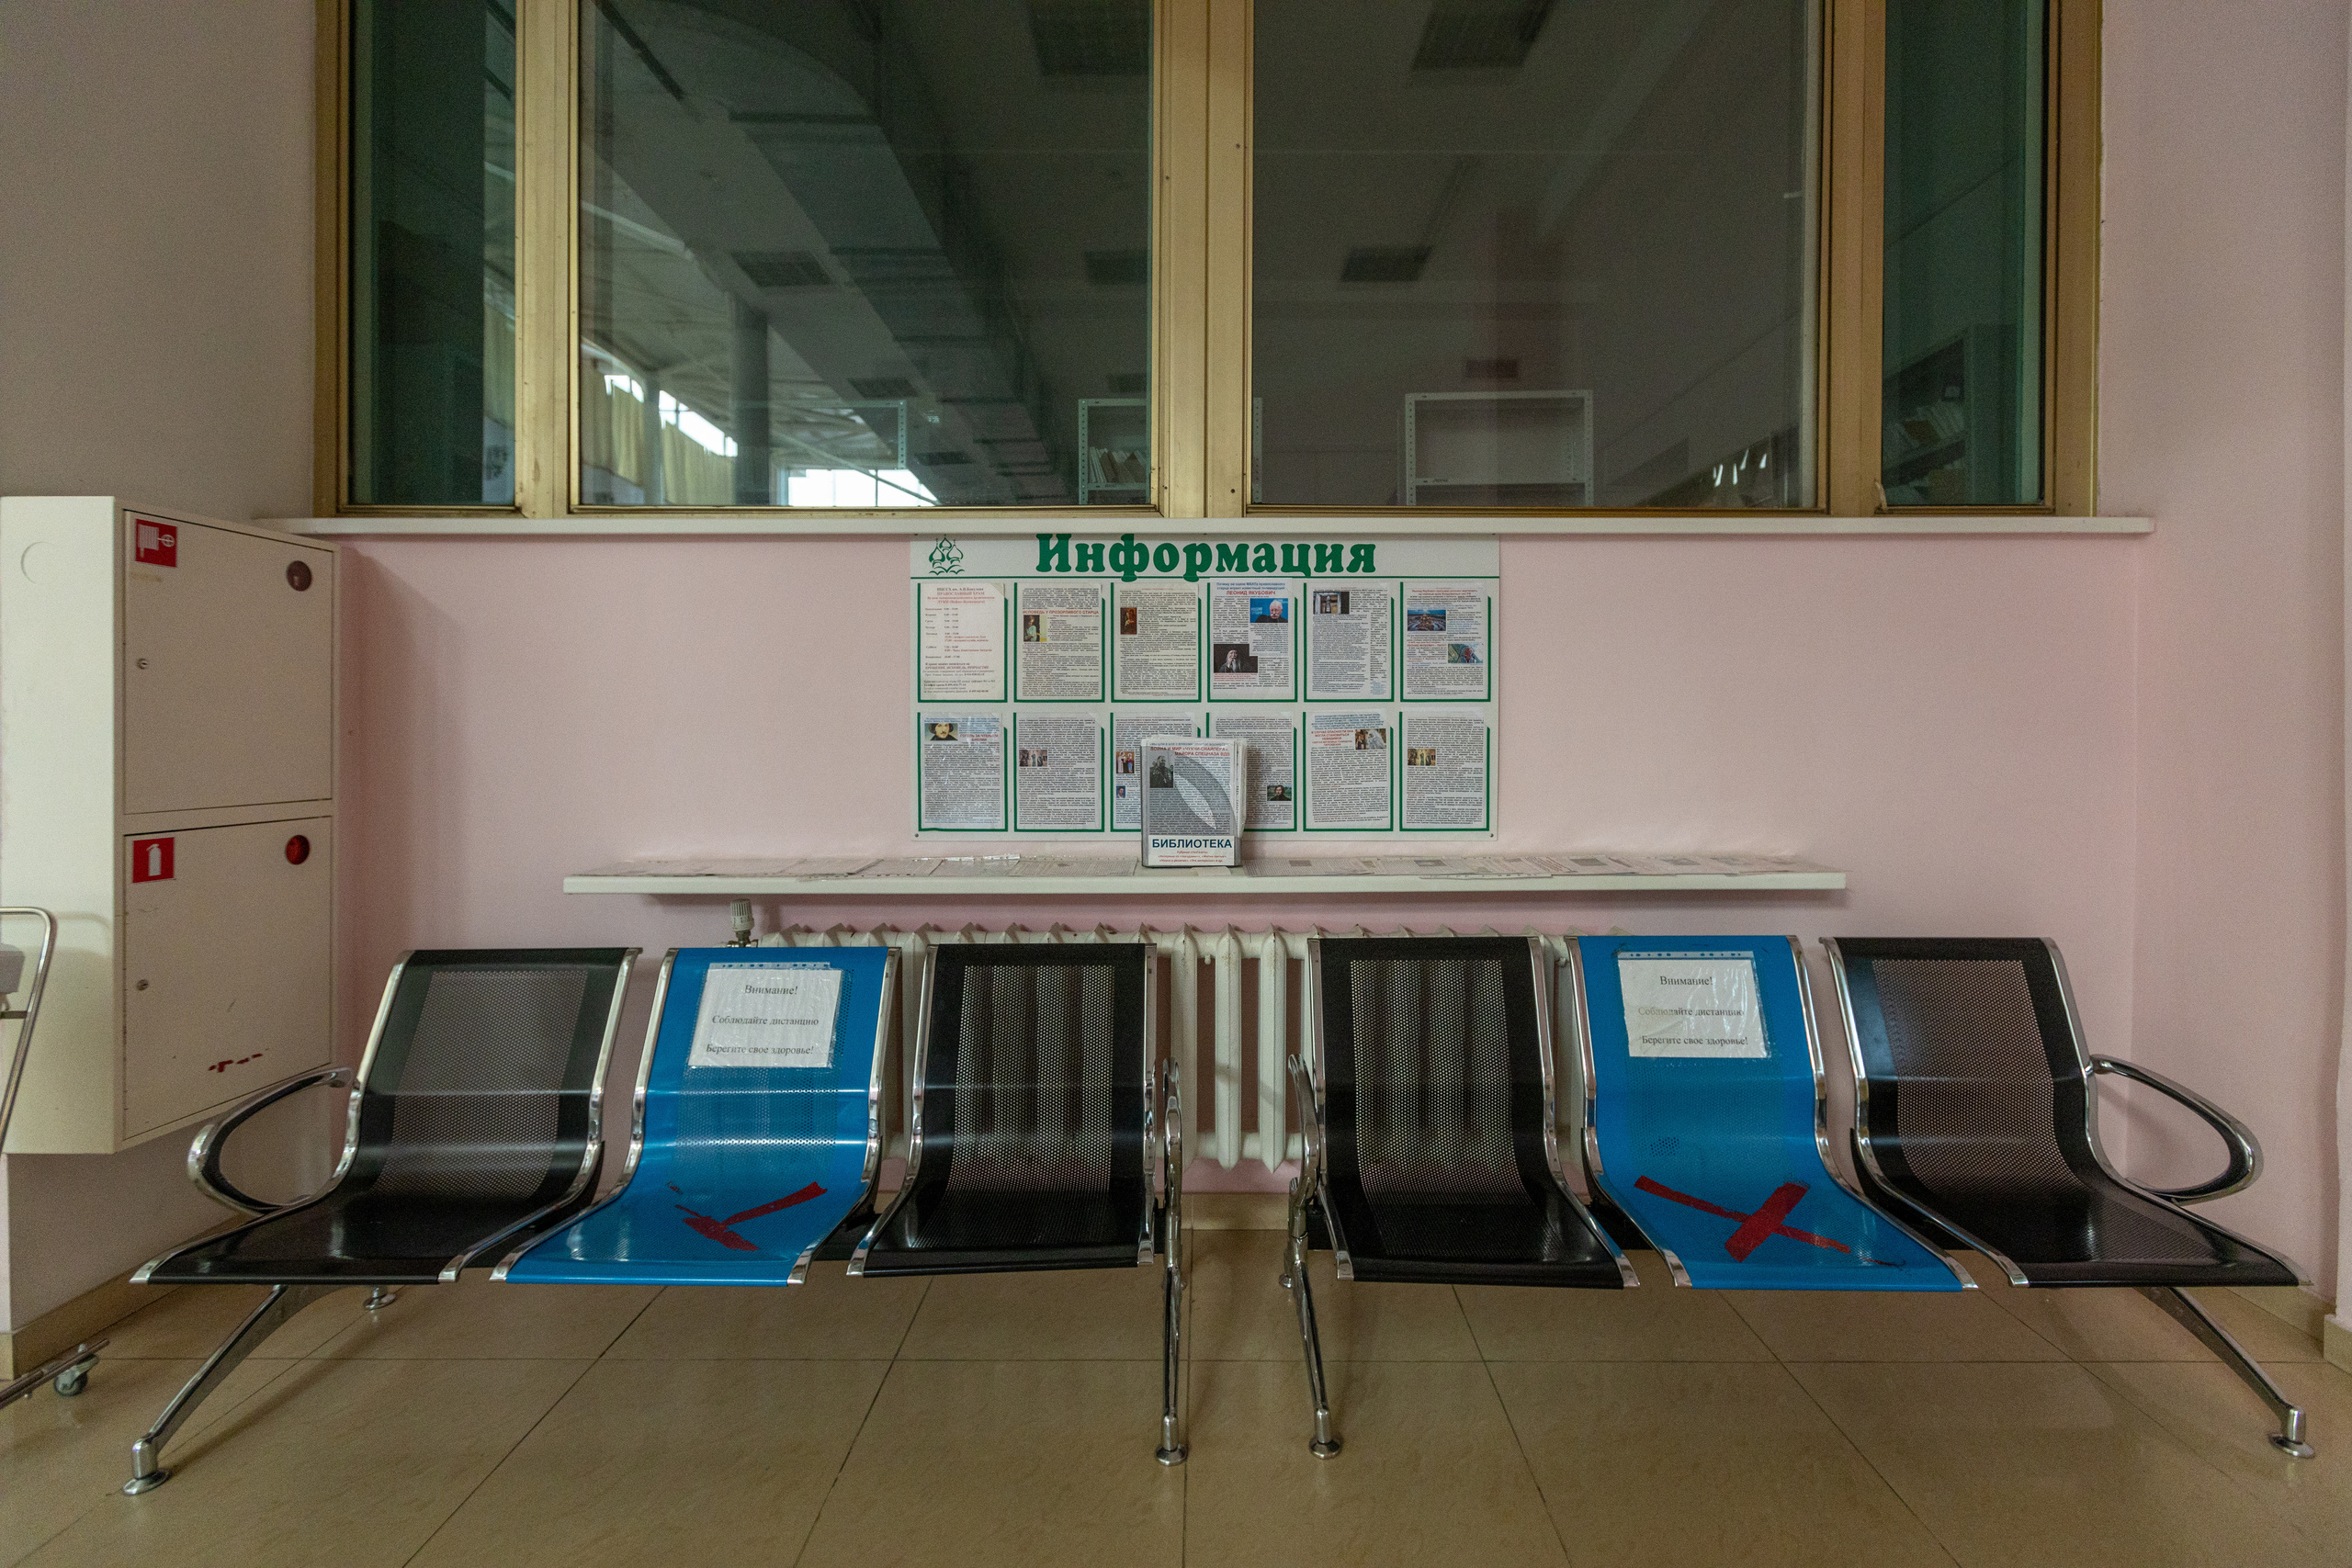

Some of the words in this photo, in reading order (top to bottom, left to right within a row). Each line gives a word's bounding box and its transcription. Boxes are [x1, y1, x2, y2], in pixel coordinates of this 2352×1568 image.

[1035, 533, 1376, 582] Информация
[1152, 839, 1232, 849] БИБЛИОТЕКА
[1659, 976, 1713, 986] Внимание!
[744, 985, 798, 995] Внимание!
[1638, 1007, 1693, 1017] Соблюдайте
[1695, 1008, 1744, 1017] дистанцию
[711, 1014, 768, 1026] Соблюдайте
[769, 1017, 820, 1026] дистанцию
[1642, 1035, 1682, 1046] Берегите
[1705, 1036, 1749, 1047] здоровье!
[706, 1043, 747, 1055] Берегите
[748, 1046, 769, 1055] свое
[771, 1045, 814, 1056] здоровье!
